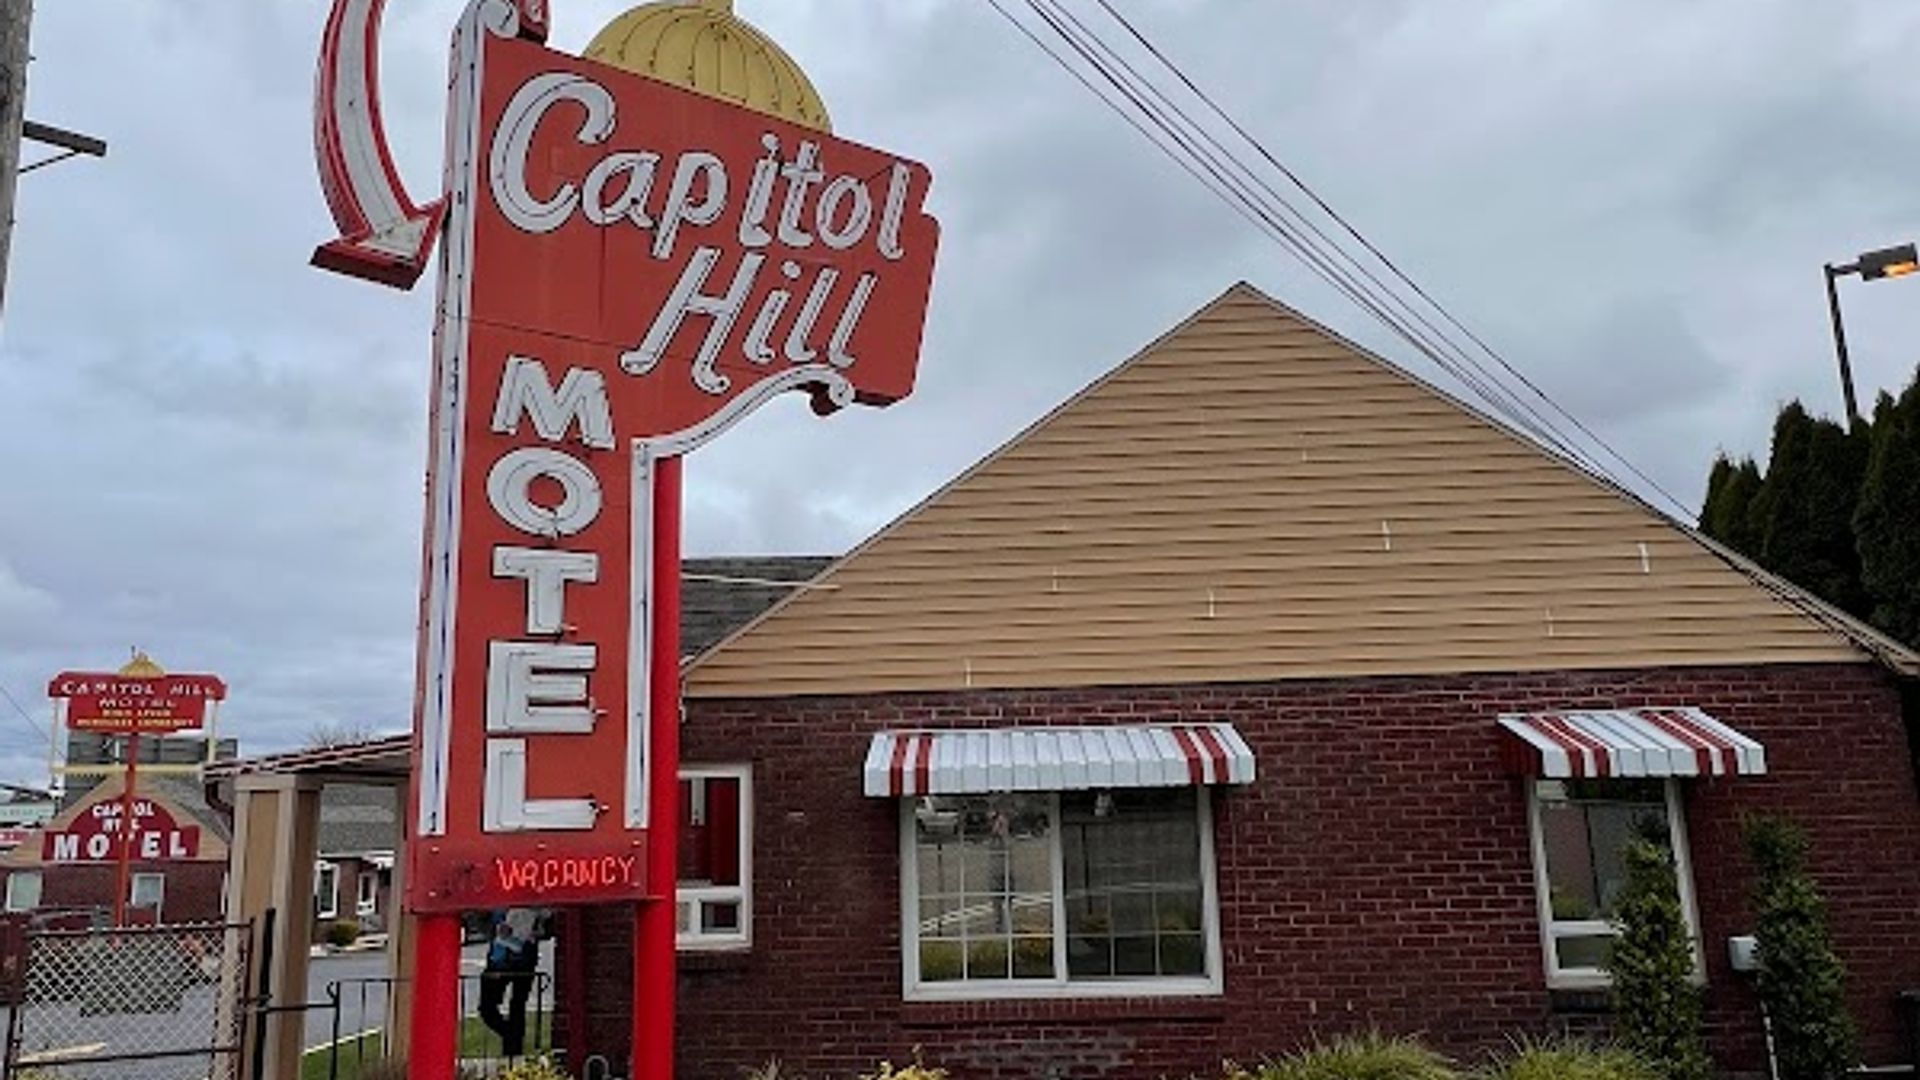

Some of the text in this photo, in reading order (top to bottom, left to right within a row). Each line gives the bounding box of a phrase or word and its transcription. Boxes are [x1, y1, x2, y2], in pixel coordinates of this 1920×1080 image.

[489, 72, 911, 259] Capitol
[619, 246, 878, 393] Hill
[483, 356, 617, 832] MOTEL
[92, 802, 155, 818] CAPOL
[496, 855, 635, 891] VACANCY
